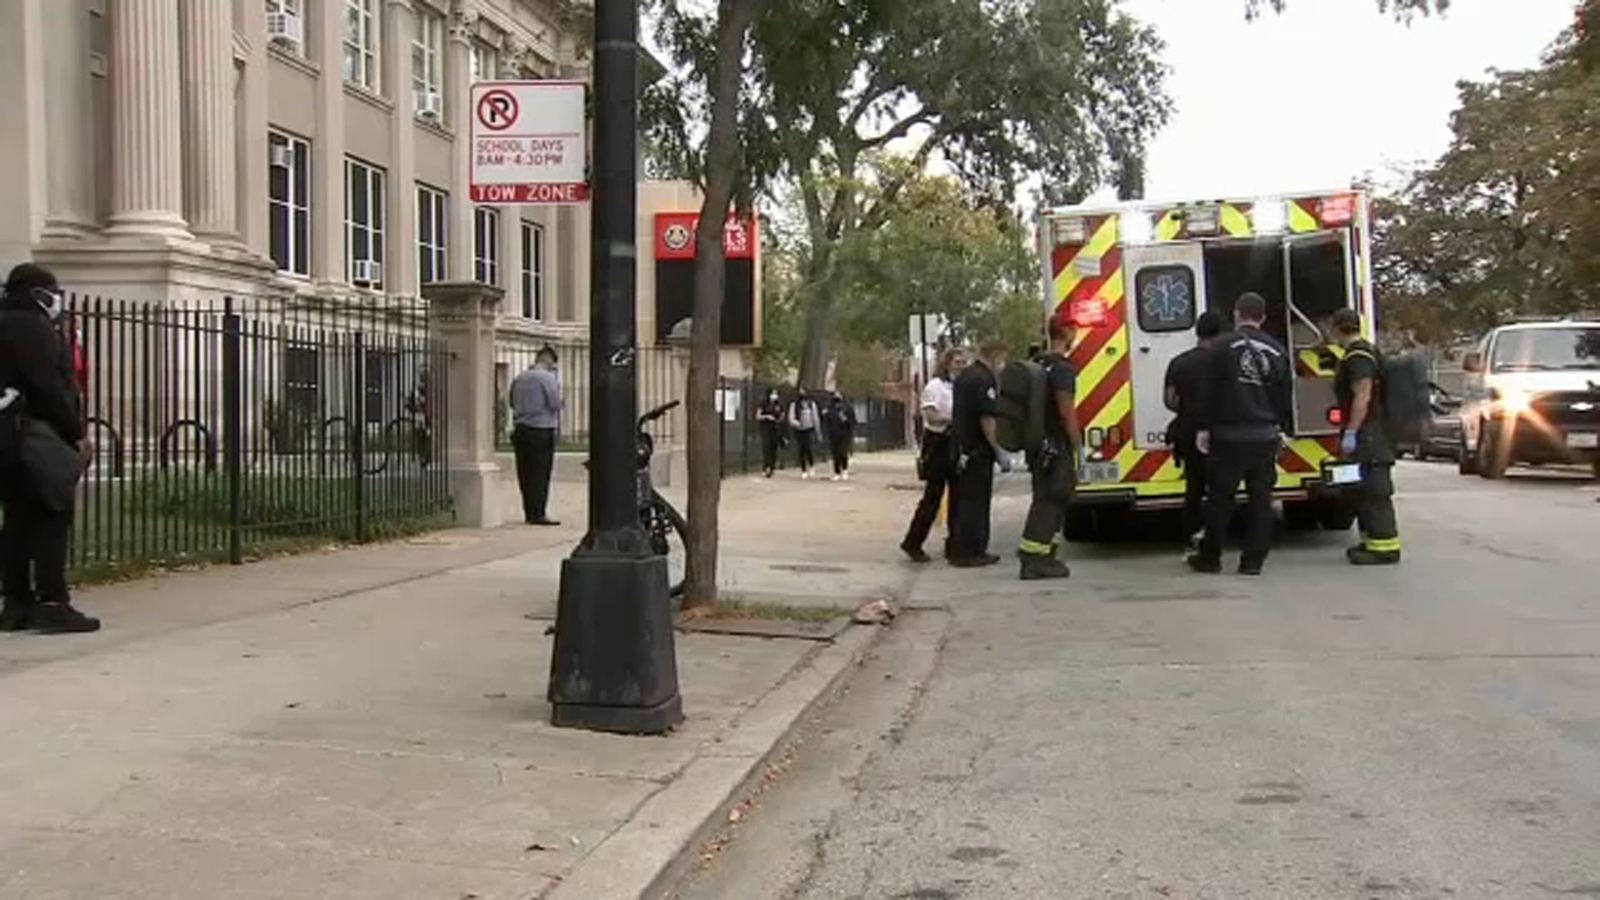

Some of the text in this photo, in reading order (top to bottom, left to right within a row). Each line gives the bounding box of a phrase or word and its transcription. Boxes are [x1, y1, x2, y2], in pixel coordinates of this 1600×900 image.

[477, 139, 564, 153] SCHOOL DAYS
[478, 184, 577, 200] TOW ZONE
